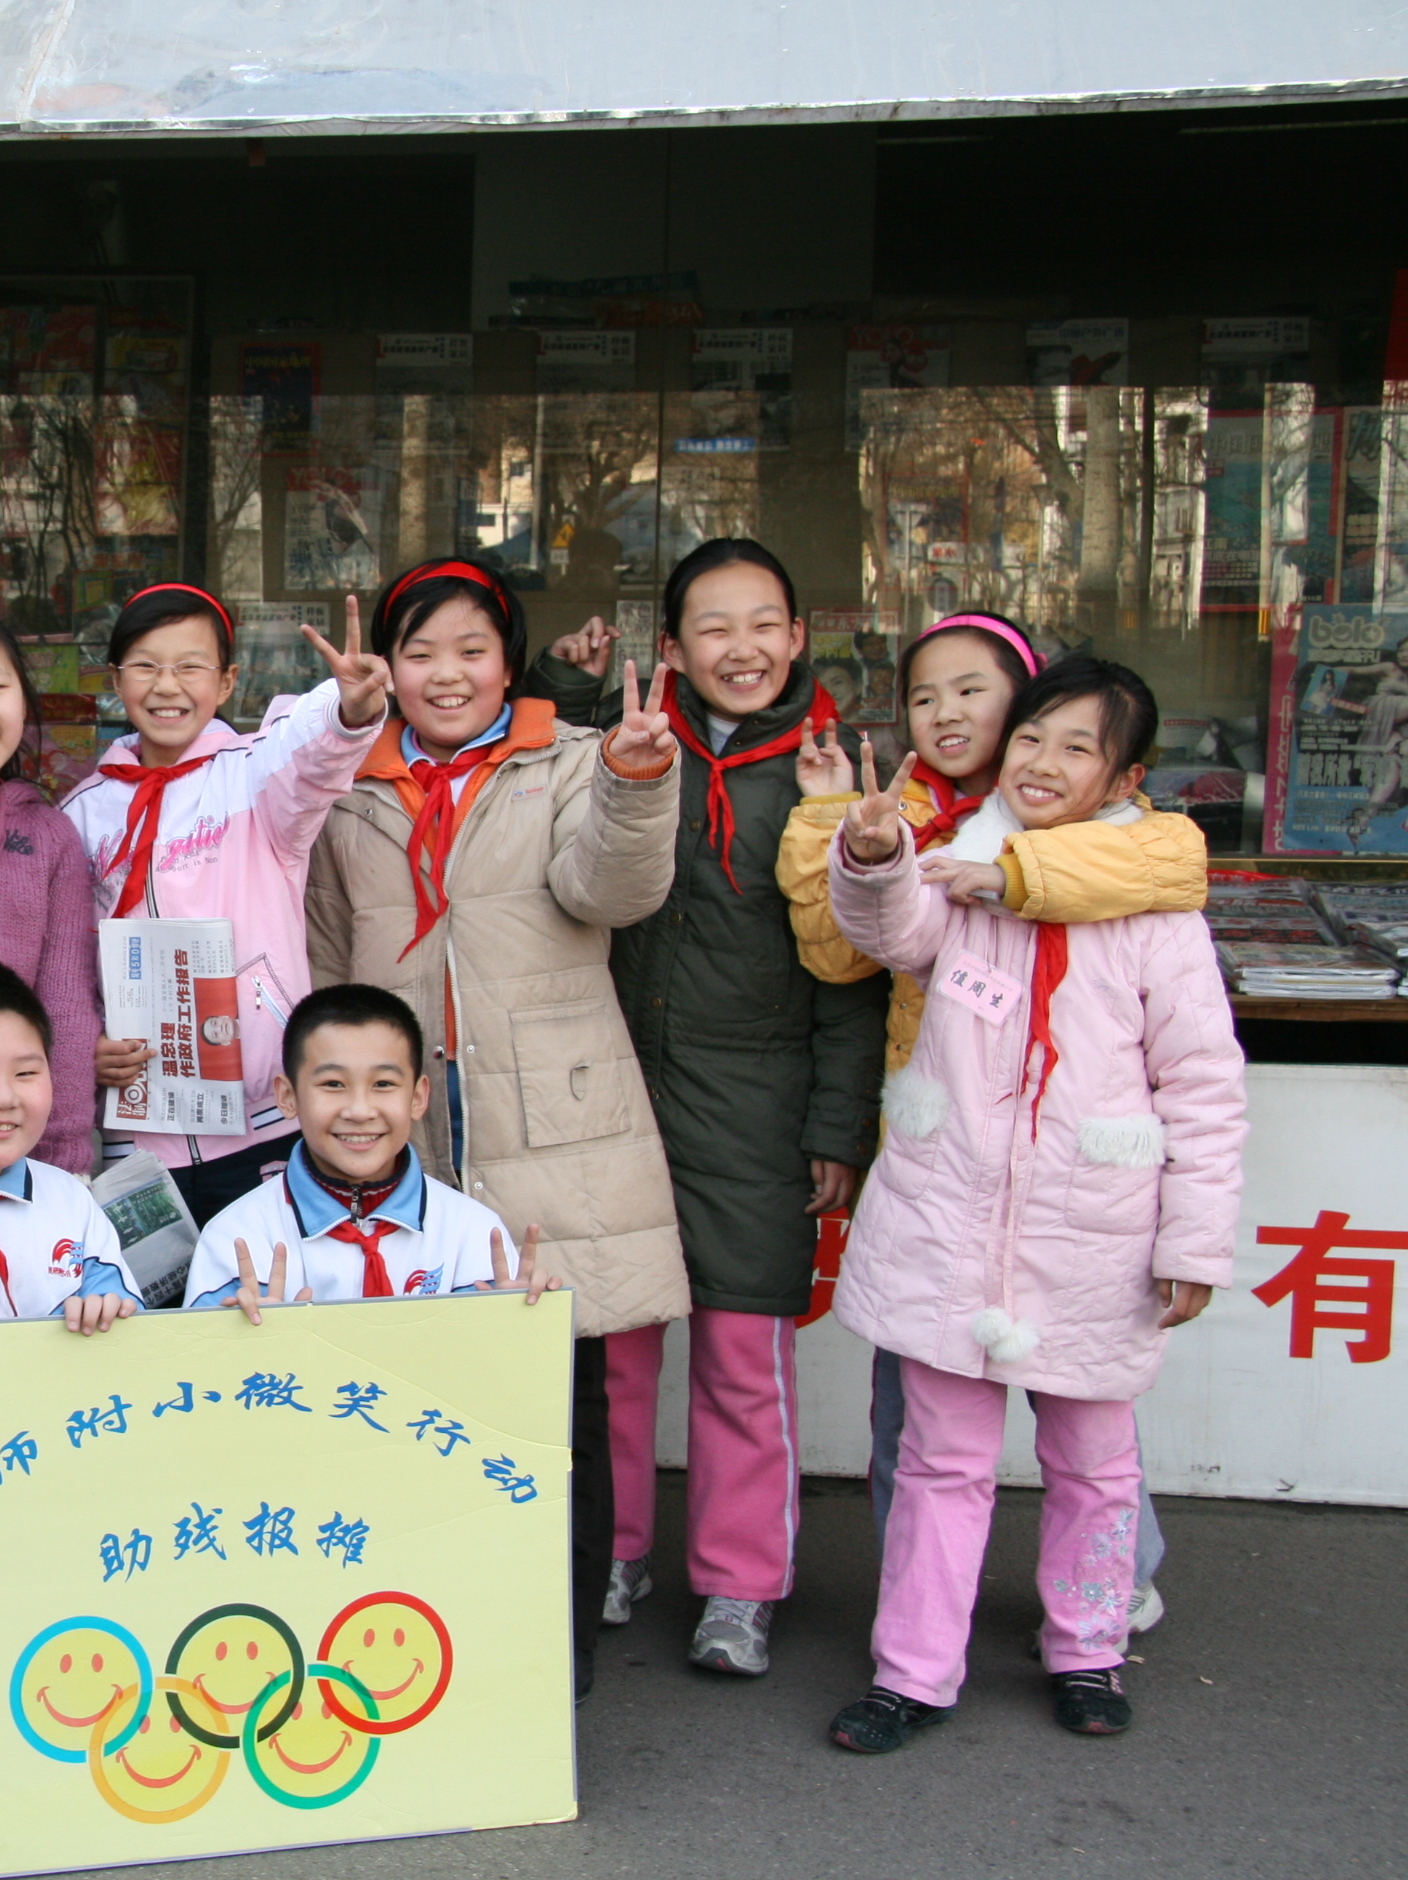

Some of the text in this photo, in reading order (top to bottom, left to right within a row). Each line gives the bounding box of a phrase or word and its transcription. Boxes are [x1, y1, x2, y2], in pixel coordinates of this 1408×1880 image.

[174, 948, 195, 1078] 作政府工作报告
[950, 969, 1004, 1009] 值周生
[160, 1022, 178, 1077] 温总理
[1251, 1209, 1408, 1364] 有
[98, 1501, 372, 1583] 助残报摊
